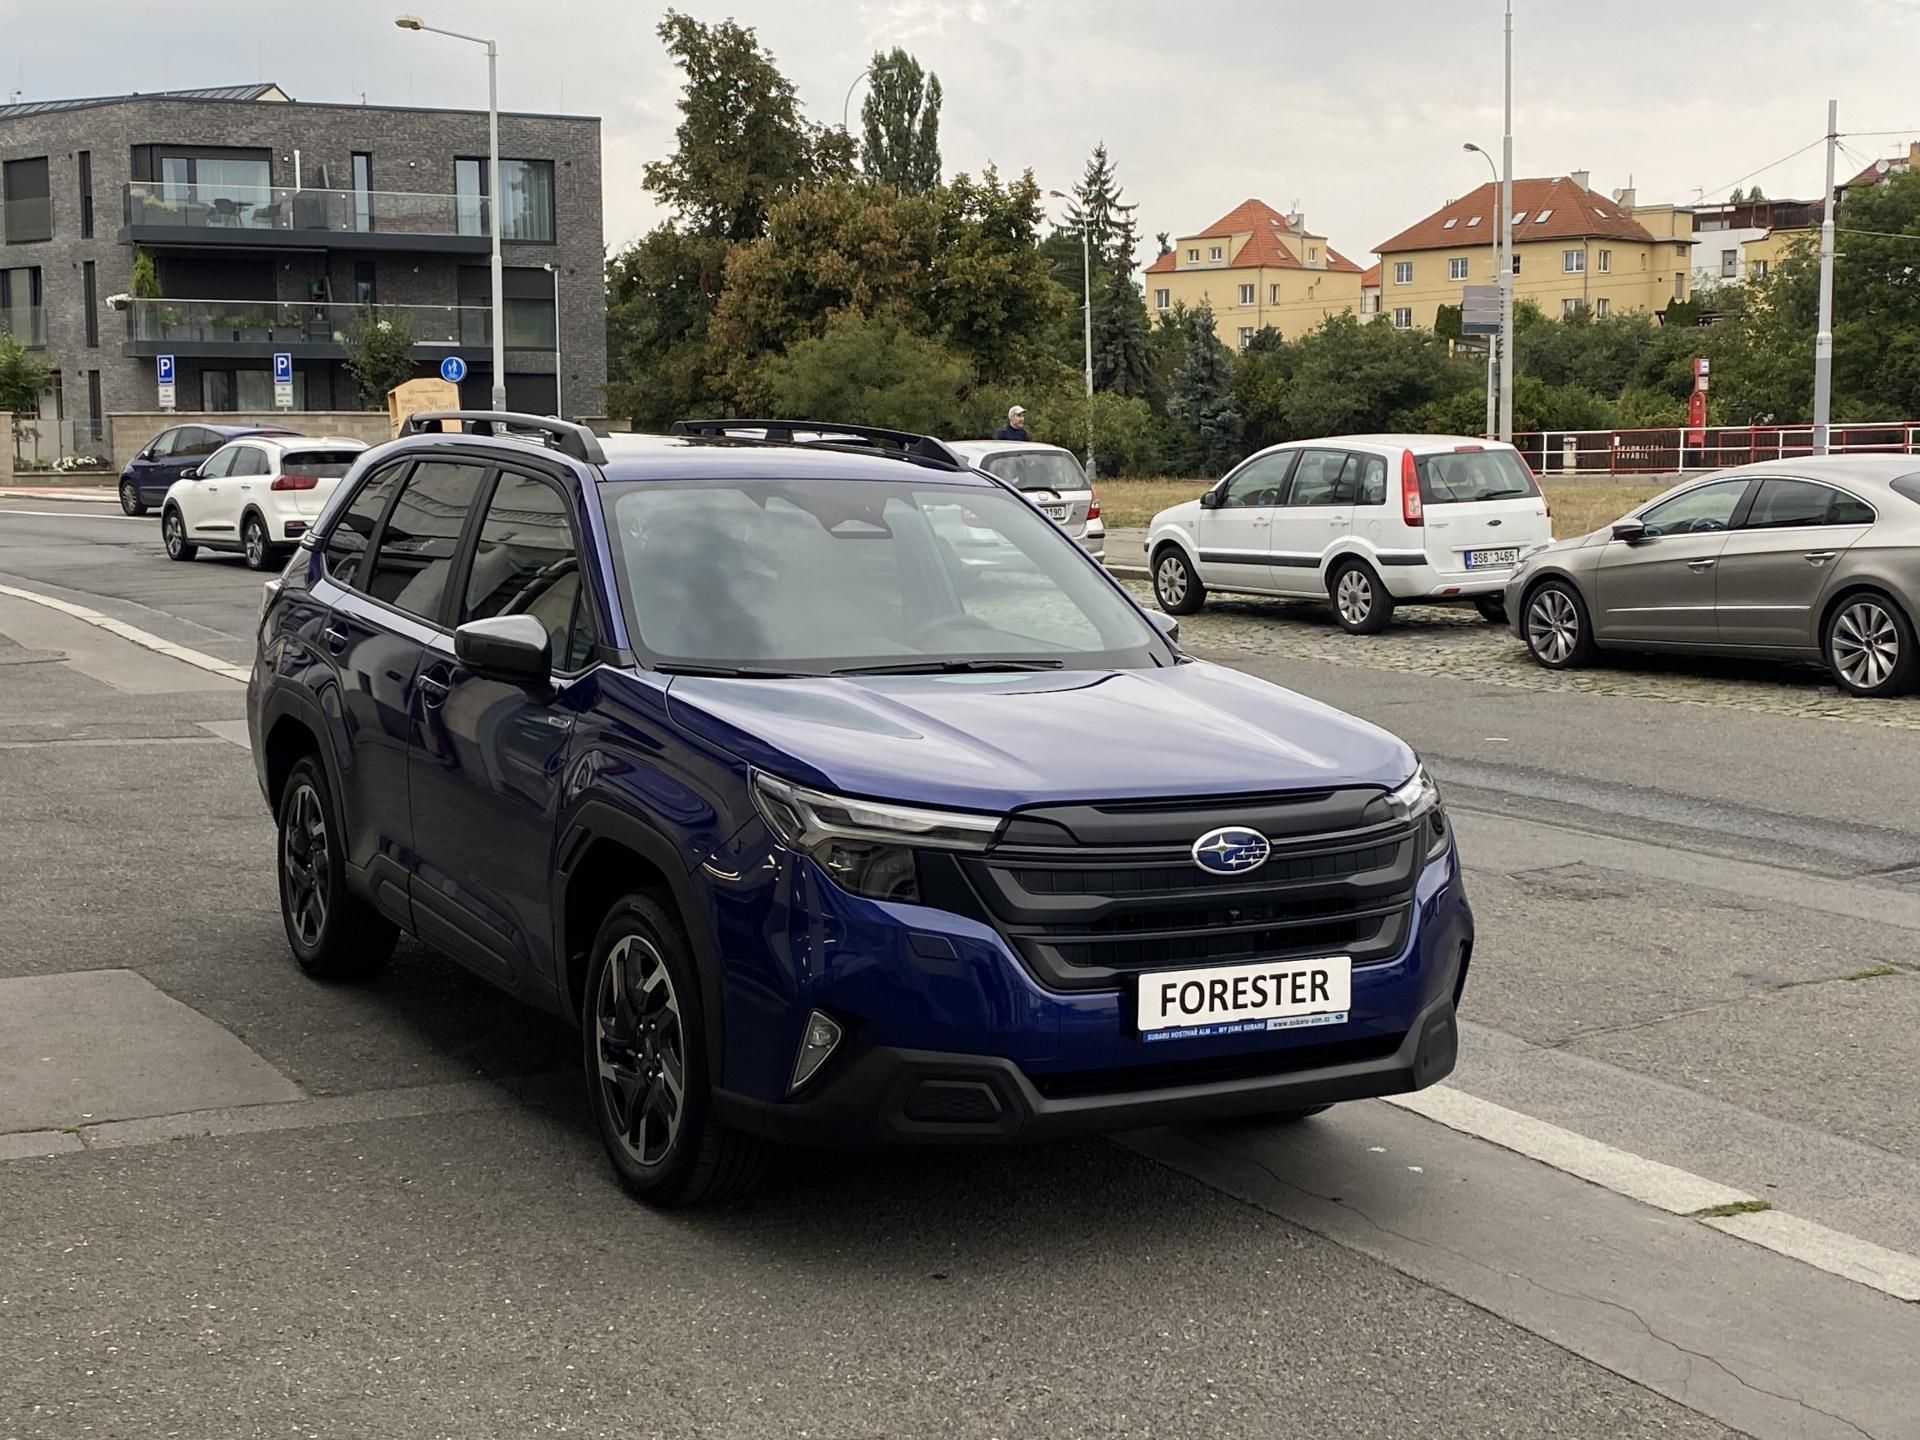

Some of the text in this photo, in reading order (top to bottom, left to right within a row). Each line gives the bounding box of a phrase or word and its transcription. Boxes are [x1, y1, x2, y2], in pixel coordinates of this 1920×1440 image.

[160, 358, 170, 376] P
[277, 357, 287, 375] P
[1473, 551, 1515, 564] 9S6 3465
[1161, 969, 1330, 1017] FORESTER
[1147, 1032, 1169, 1041] SUBARU
[1243, 1022, 1265, 1032] SUBARU
